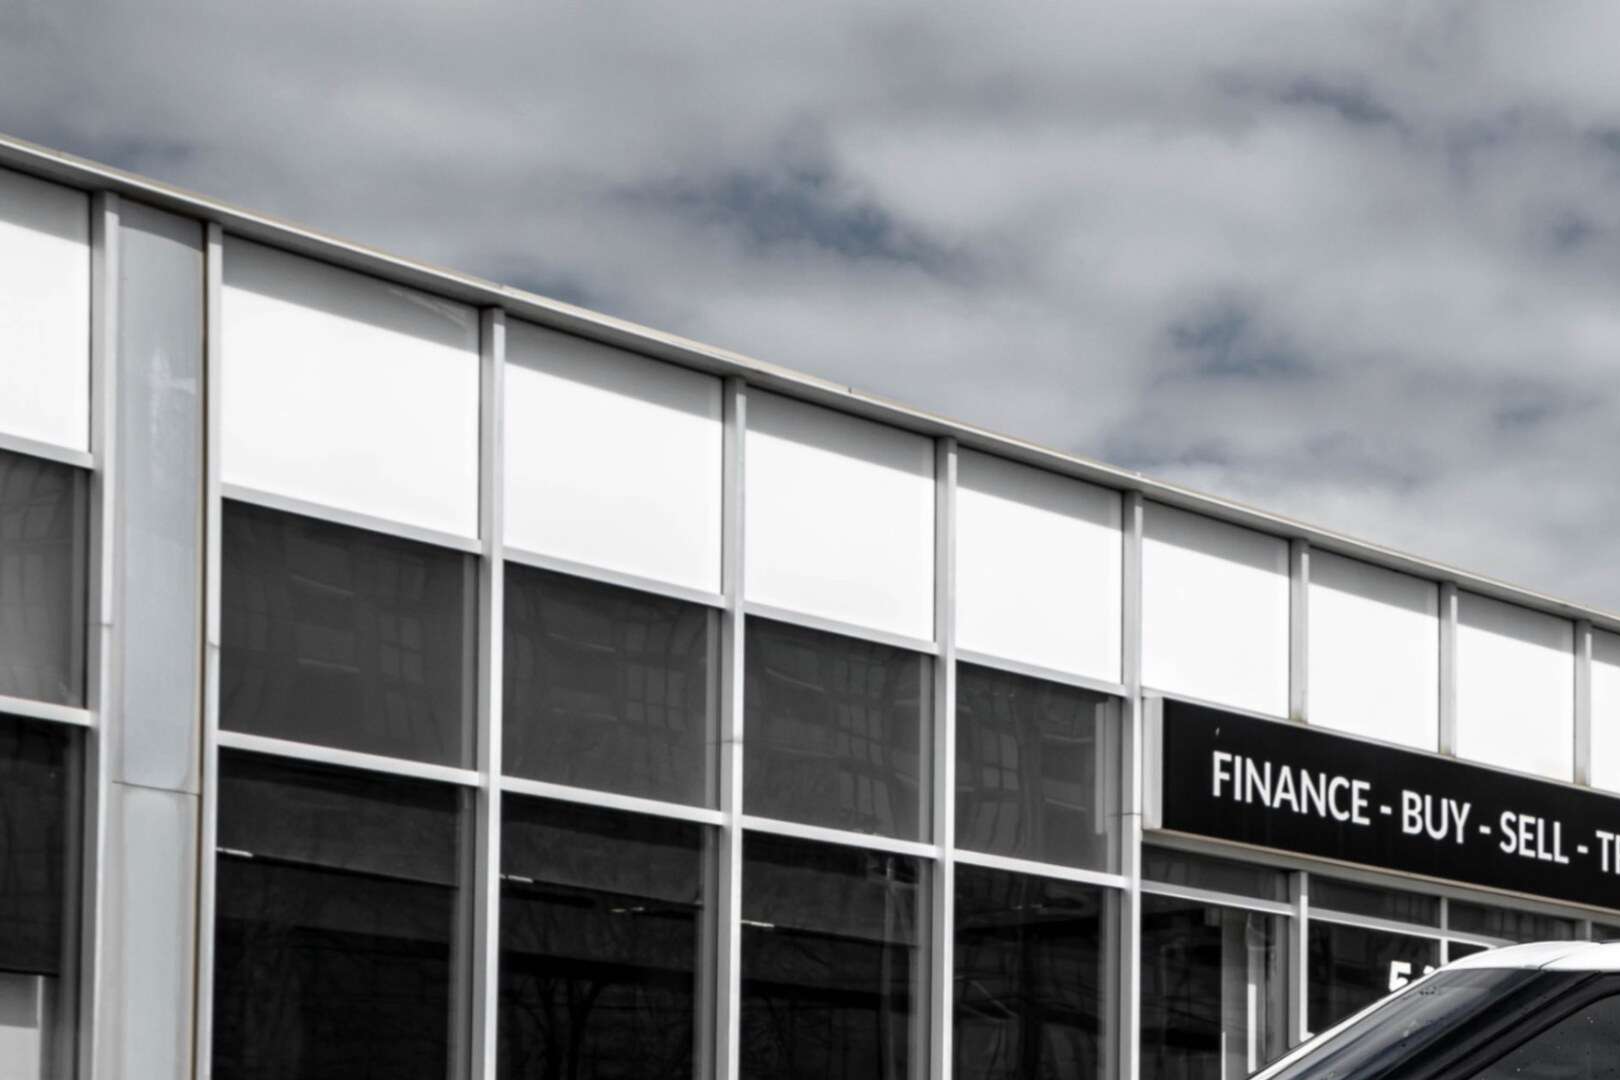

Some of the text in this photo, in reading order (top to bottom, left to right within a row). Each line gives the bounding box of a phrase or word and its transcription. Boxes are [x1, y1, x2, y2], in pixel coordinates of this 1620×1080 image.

[1211, 749, 1372, 827] FINANCE
[1401, 788, 1471, 845] BUY
[1499, 809, 1570, 865] SELL
